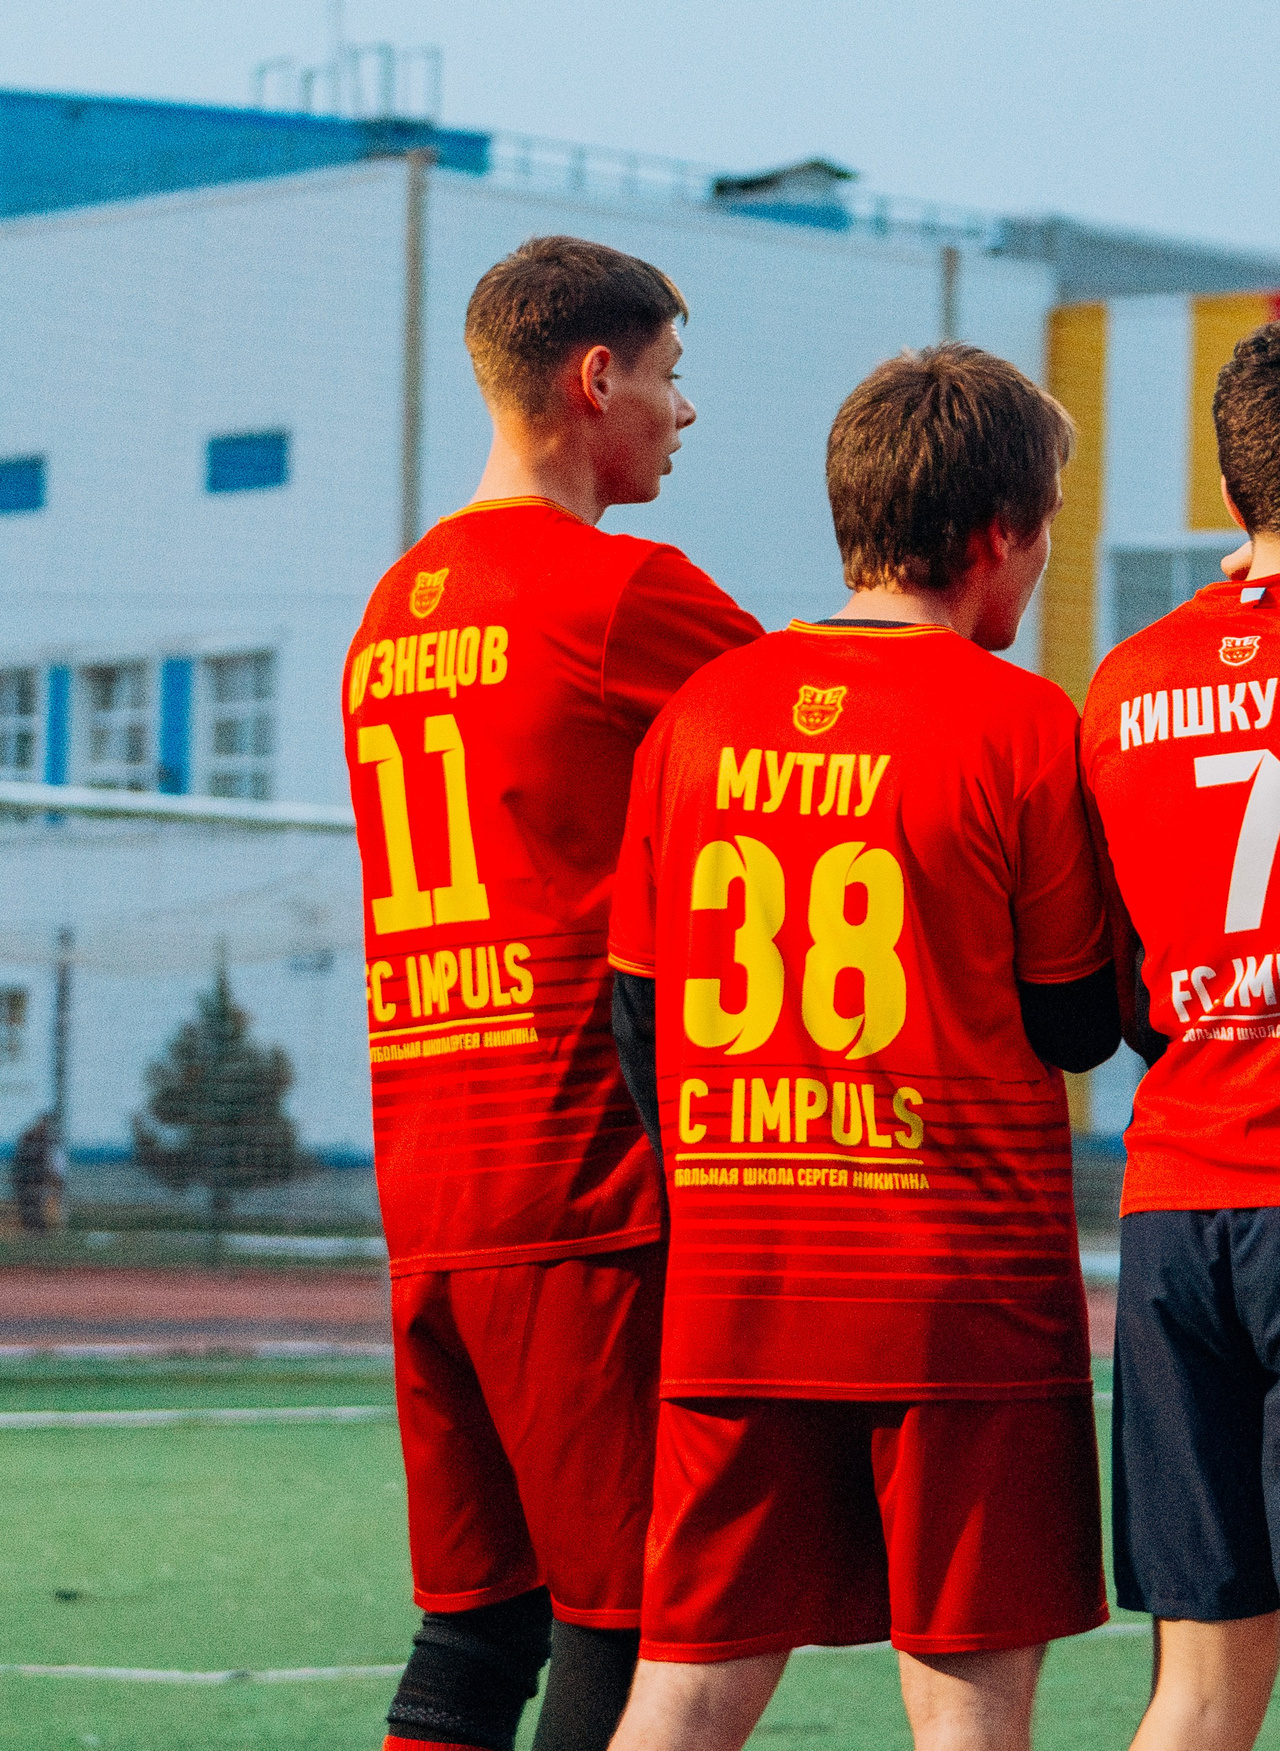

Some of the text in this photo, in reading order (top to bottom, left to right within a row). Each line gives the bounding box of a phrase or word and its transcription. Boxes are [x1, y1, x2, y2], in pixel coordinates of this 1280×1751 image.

[716, 747, 891, 817] МУТЛУ
[357, 714, 491, 935] 11
[406, 943, 535, 1019] IMPULS
[684, 835, 907, 1060] 38
[730, 1076, 925, 1149] IMPULS
[742, 1167, 795, 1186] ШКОЛА
[797, 1167, 848, 1187] СЕРГЕЯ
[852, 1170, 930, 1190] НИКИТИНА
